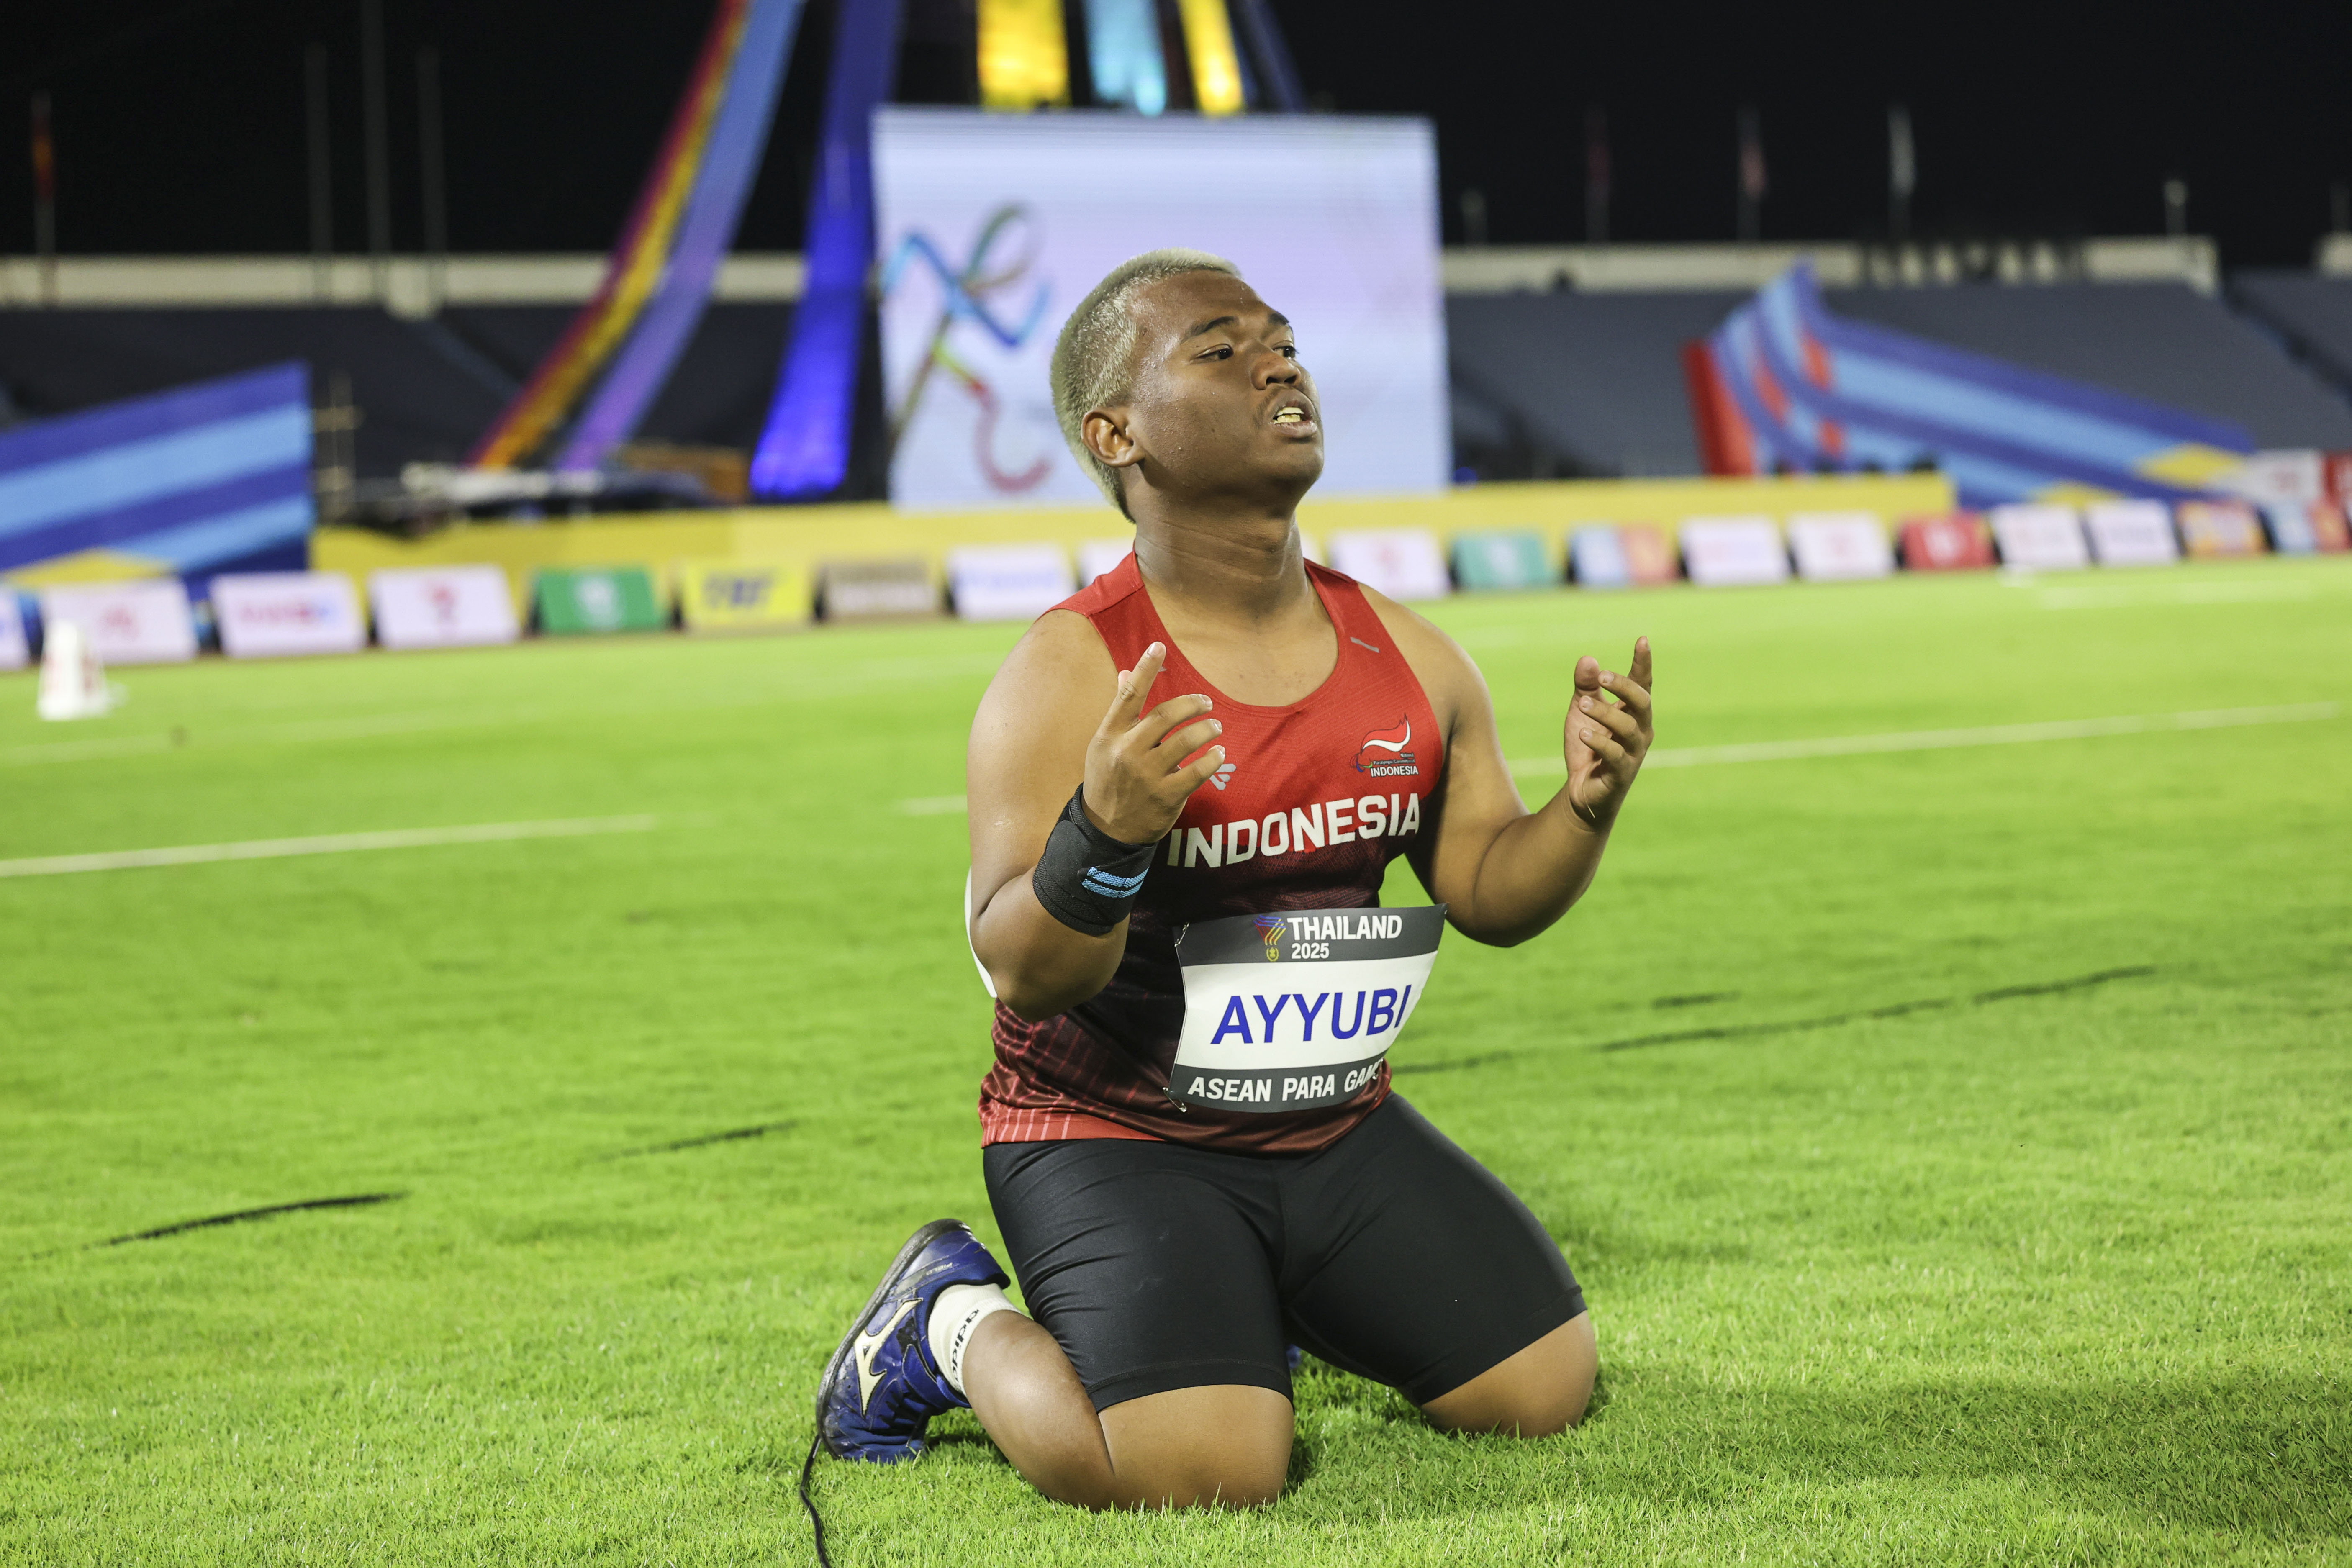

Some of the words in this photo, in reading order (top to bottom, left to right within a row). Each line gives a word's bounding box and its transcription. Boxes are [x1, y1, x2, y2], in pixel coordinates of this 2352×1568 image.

[1371, 765, 1419, 777] INDONESIA
[1167, 793, 1420, 868] INDONESIA
[1287, 915, 1402, 940] THAILAND
[1291, 942, 1330, 959] 2025
[1210, 984, 1412, 1044] AYYUBI
[1188, 1077, 1271, 1102] ASEAN
[1282, 1074, 1335, 1101] PARA
[1344, 1060, 1381, 1092] GAM
[952, 1309, 979, 1383] adida
